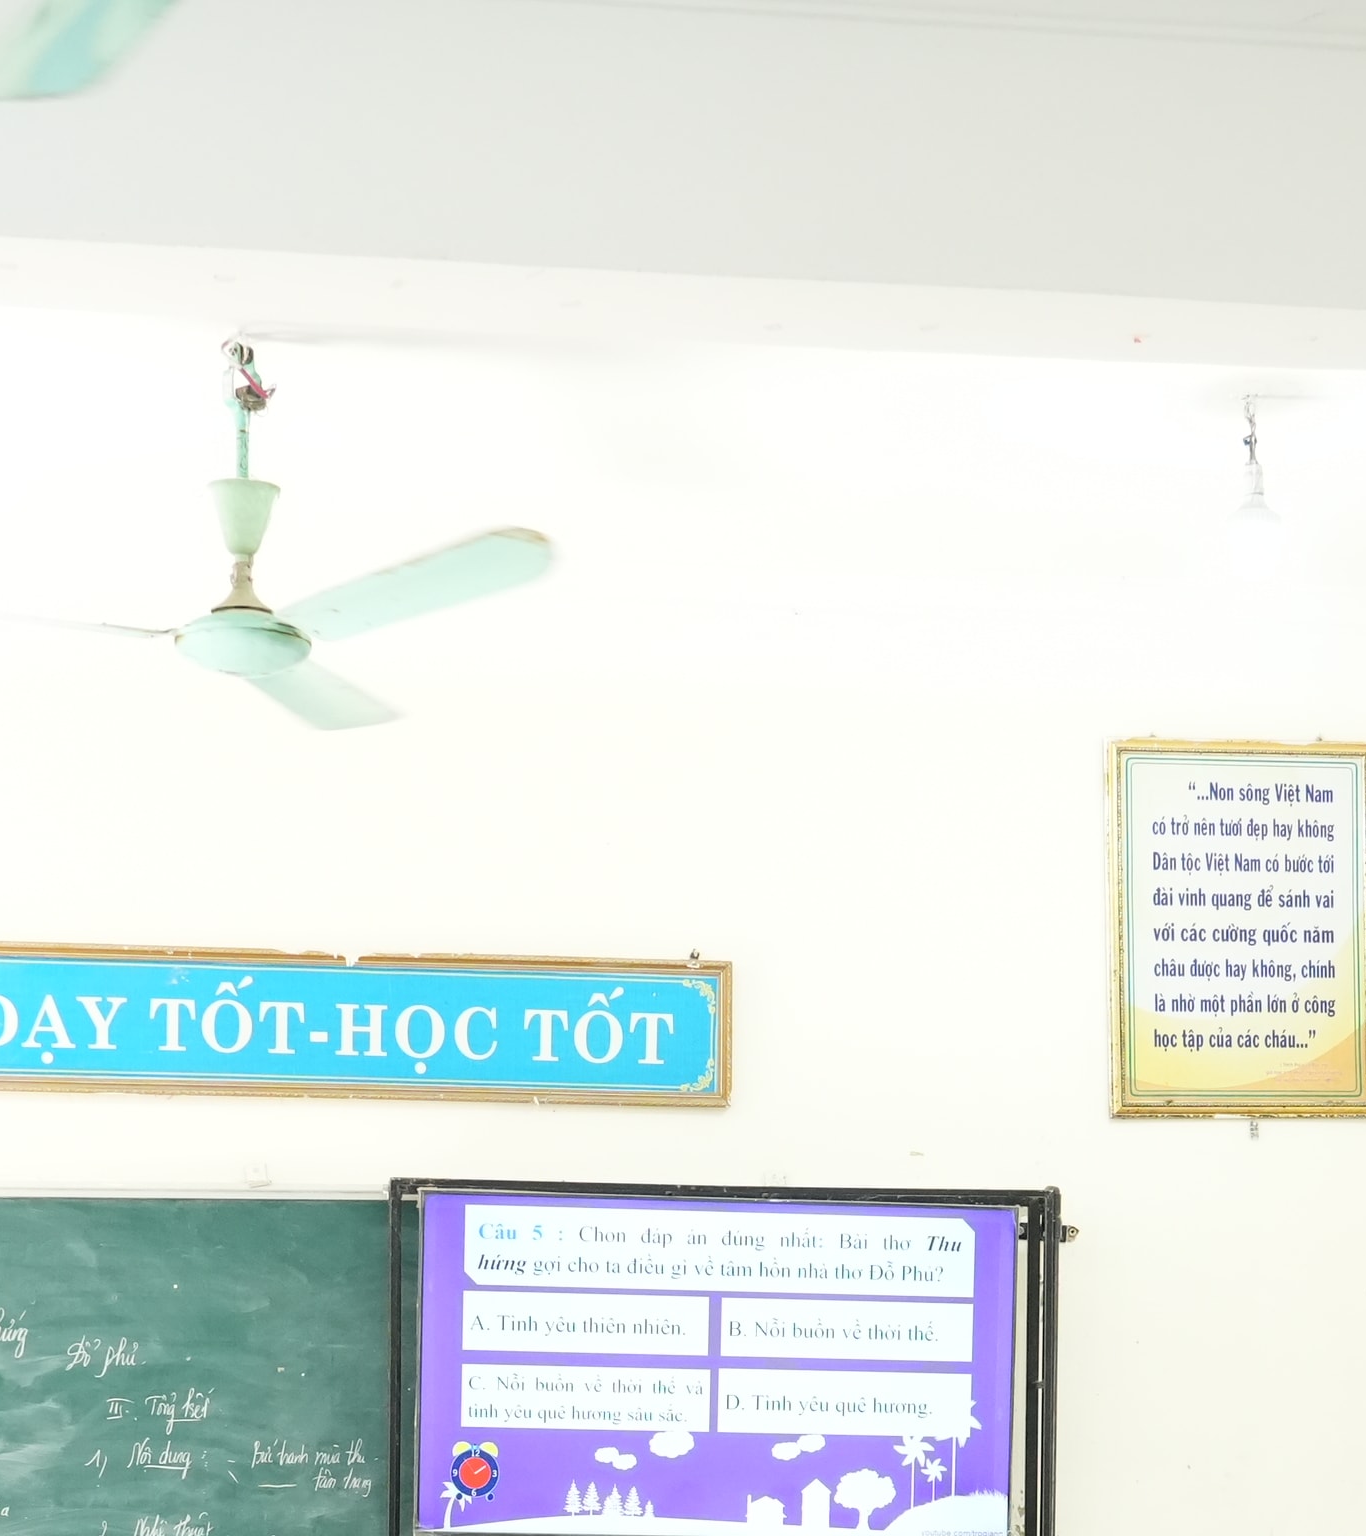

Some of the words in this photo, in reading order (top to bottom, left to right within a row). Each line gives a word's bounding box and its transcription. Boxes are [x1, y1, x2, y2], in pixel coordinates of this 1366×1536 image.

[1239, 783, 1270, 805] sông
[1275, 783, 1300, 807] Việt
[1305, 784, 1333, 803] Nam
[1152, 816, 1166, 835] có
[1171, 814, 1189, 836] trở
[1194, 818, 1215, 836] nên
[1247, 818, 1268, 841] đẹp
[1273, 818, 1293, 841] hay
[1298, 819, 1335, 842] không
[1153, 851, 1176, 871] Dân
[1181, 853, 1201, 876] tộc
[1205, 852, 1230, 876] Việt
[1234, 853, 1261, 872] Nam
[1265, 853, 1279, 872] có
[1285, 854, 1314, 873] bước
[1318, 854, 1334, 874] tới
[1153, 887, 1173, 906] đài
[1178, 888, 1206, 907] vinh
[1211, 893, 1252, 911] quang
[1257, 885, 1274, 908] để
[1278, 889, 1310, 908] sánh
[1315, 890, 1334, 909] vai
[1153, 922, 1175, 942] với
[1180, 923, 1206, 942] các
[1212, 923, 1257, 946] cường
[1263, 922, 1297, 946] quốc
[1303, 926, 1334, 944] năm
[1154, 958, 1185, 977] châu
[1190, 958, 1220, 981] được
[1225, 958, 1247, 981] hay
[1252, 959, 1296, 982] không,
[1301, 960, 1335, 979] chính
[1155, 993, 1166, 1012] là
[1172, 993, 1195, 1012] nhờ
[1200, 994, 1225, 1017] một
[1230, 991, 1262, 1016] phần
[1267, 994, 1287, 1013] lớn
[1291, 992, 1300, 1013] ở
[1304, 995, 1336, 1017] công
[149, 978, 498, 1075] TỐT-HỌC
[524, 987, 676, 1066] TỐT
[1154, 1028, 1177, 1052] học
[1182, 1029, 1204, 1052] tập
[1209, 1027, 1232, 1048] của
[1237, 1029, 1259, 1048] các
[479, 1224, 516, 1239] Câu
[533, 1225, 542, 1240] 5
[928, 1236, 961, 1252] Thu
[478, 1254, 527, 1275] hứng
[568, 1257, 599, 1272] cho
[607, 1261, 620, 1273] ta
[721, 1261, 751, 1277] tâm
[471, 1315, 489, 1330] A.
[545, 1317, 575, 1336] yêu
[583, 1317, 625, 1333] thiên
[730, 1321, 746, 1336] B.
[468, 1375, 486, 1391] C.
[572, 1405, 621, 1425] hương
[726, 1394, 744, 1410] D.
[799, 1396, 828, 1415] yêu
[836, 1397, 866, 1416] quê
[471, 1449, 481, 1457] 12
[452, 1468, 458, 1477] 9
[492, 1469, 498, 1478] 3
[471, 1488, 477, 1497] 6
